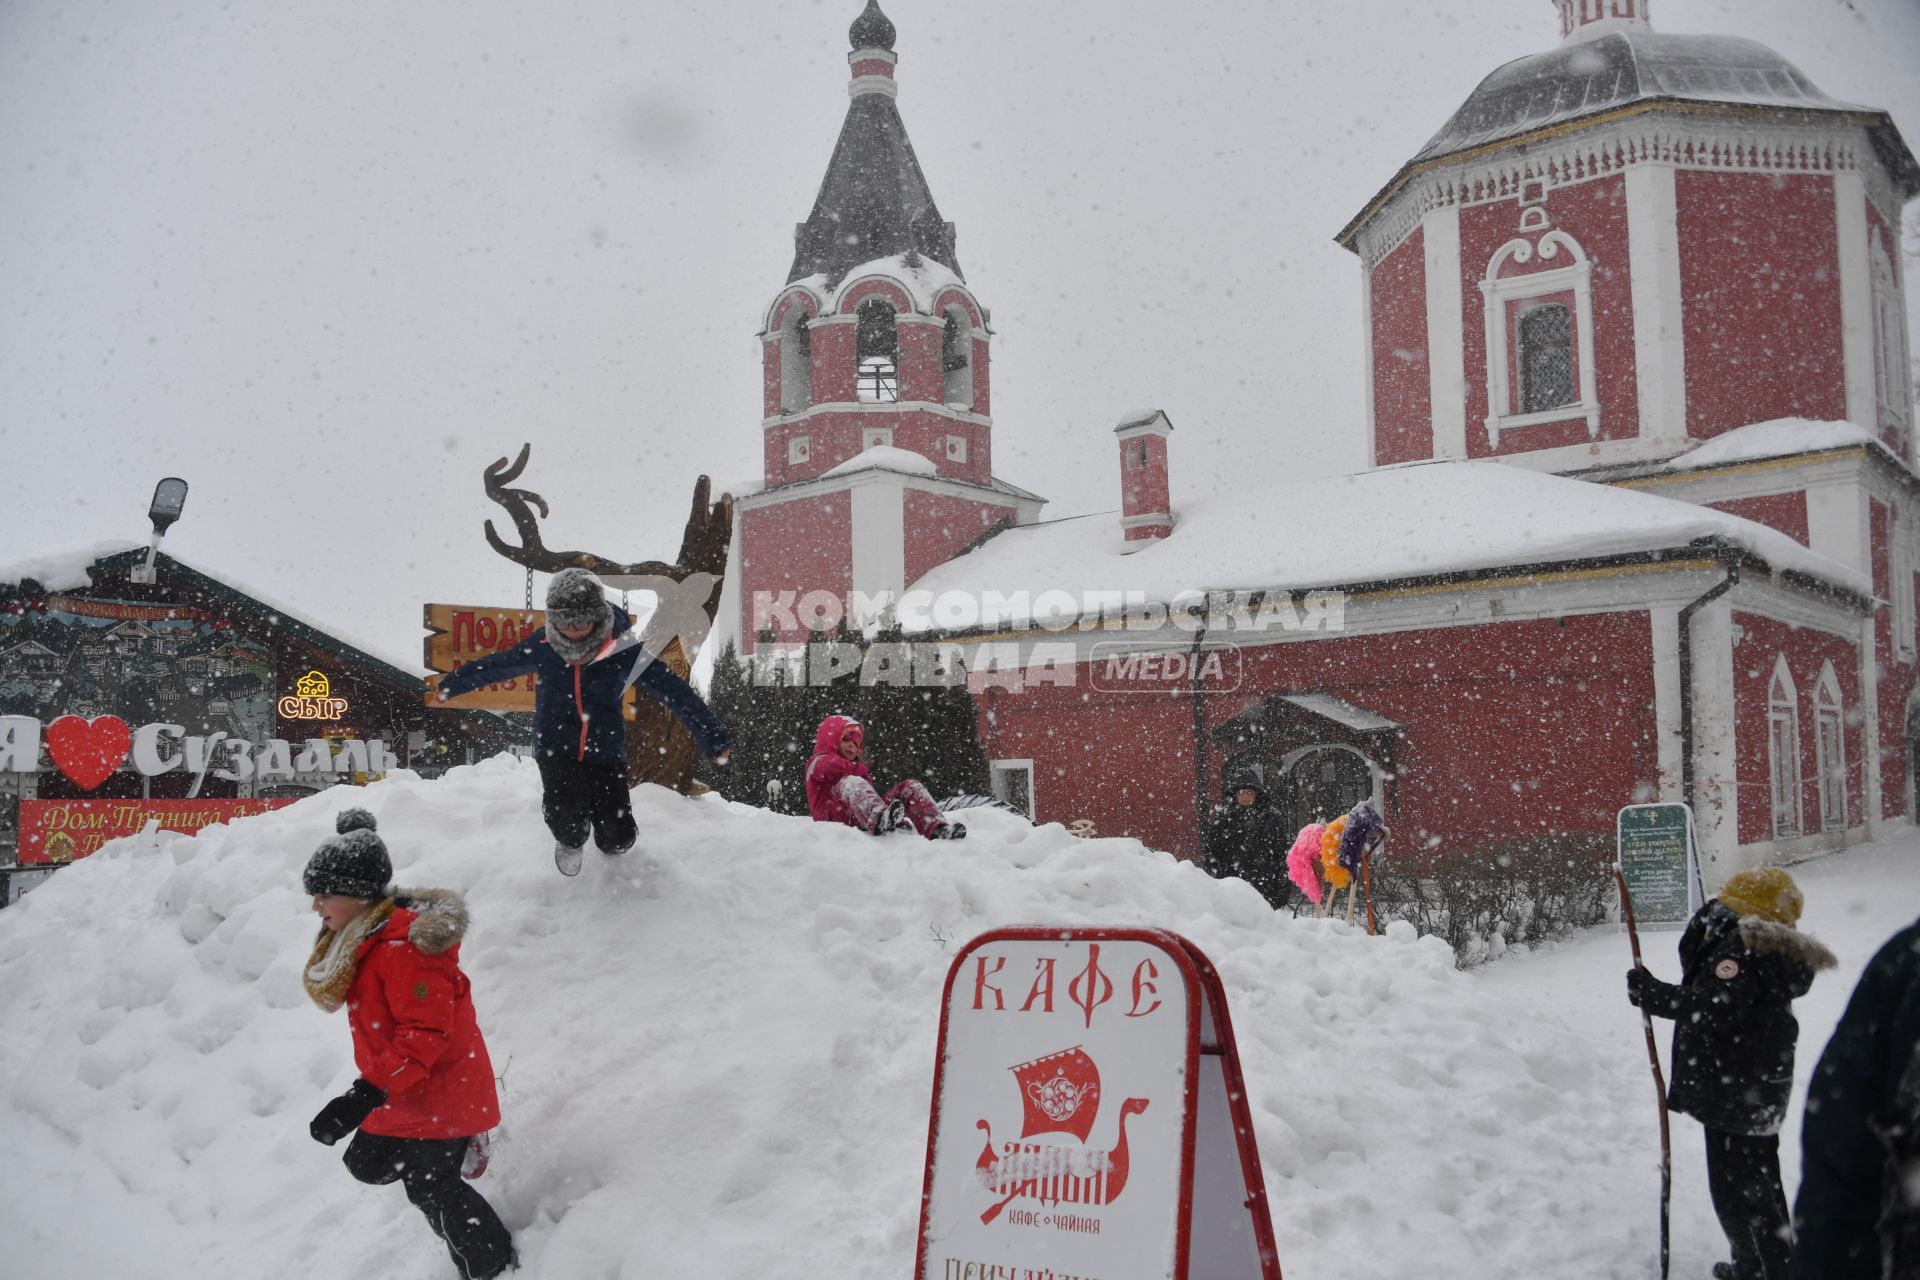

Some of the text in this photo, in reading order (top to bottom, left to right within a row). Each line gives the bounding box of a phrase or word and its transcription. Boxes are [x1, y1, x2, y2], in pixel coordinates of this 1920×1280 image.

[278, 696, 349, 720] СЫР
[0, 714, 398, 798] Я Суздаль
[43, 806, 105, 830] Дом
[111, 803, 222, 834] Пряника
[971, 943, 1162, 1029] КАФЕ
[1009, 1209, 1101, 1235] КАФЕ ЧАЙНАЯ
